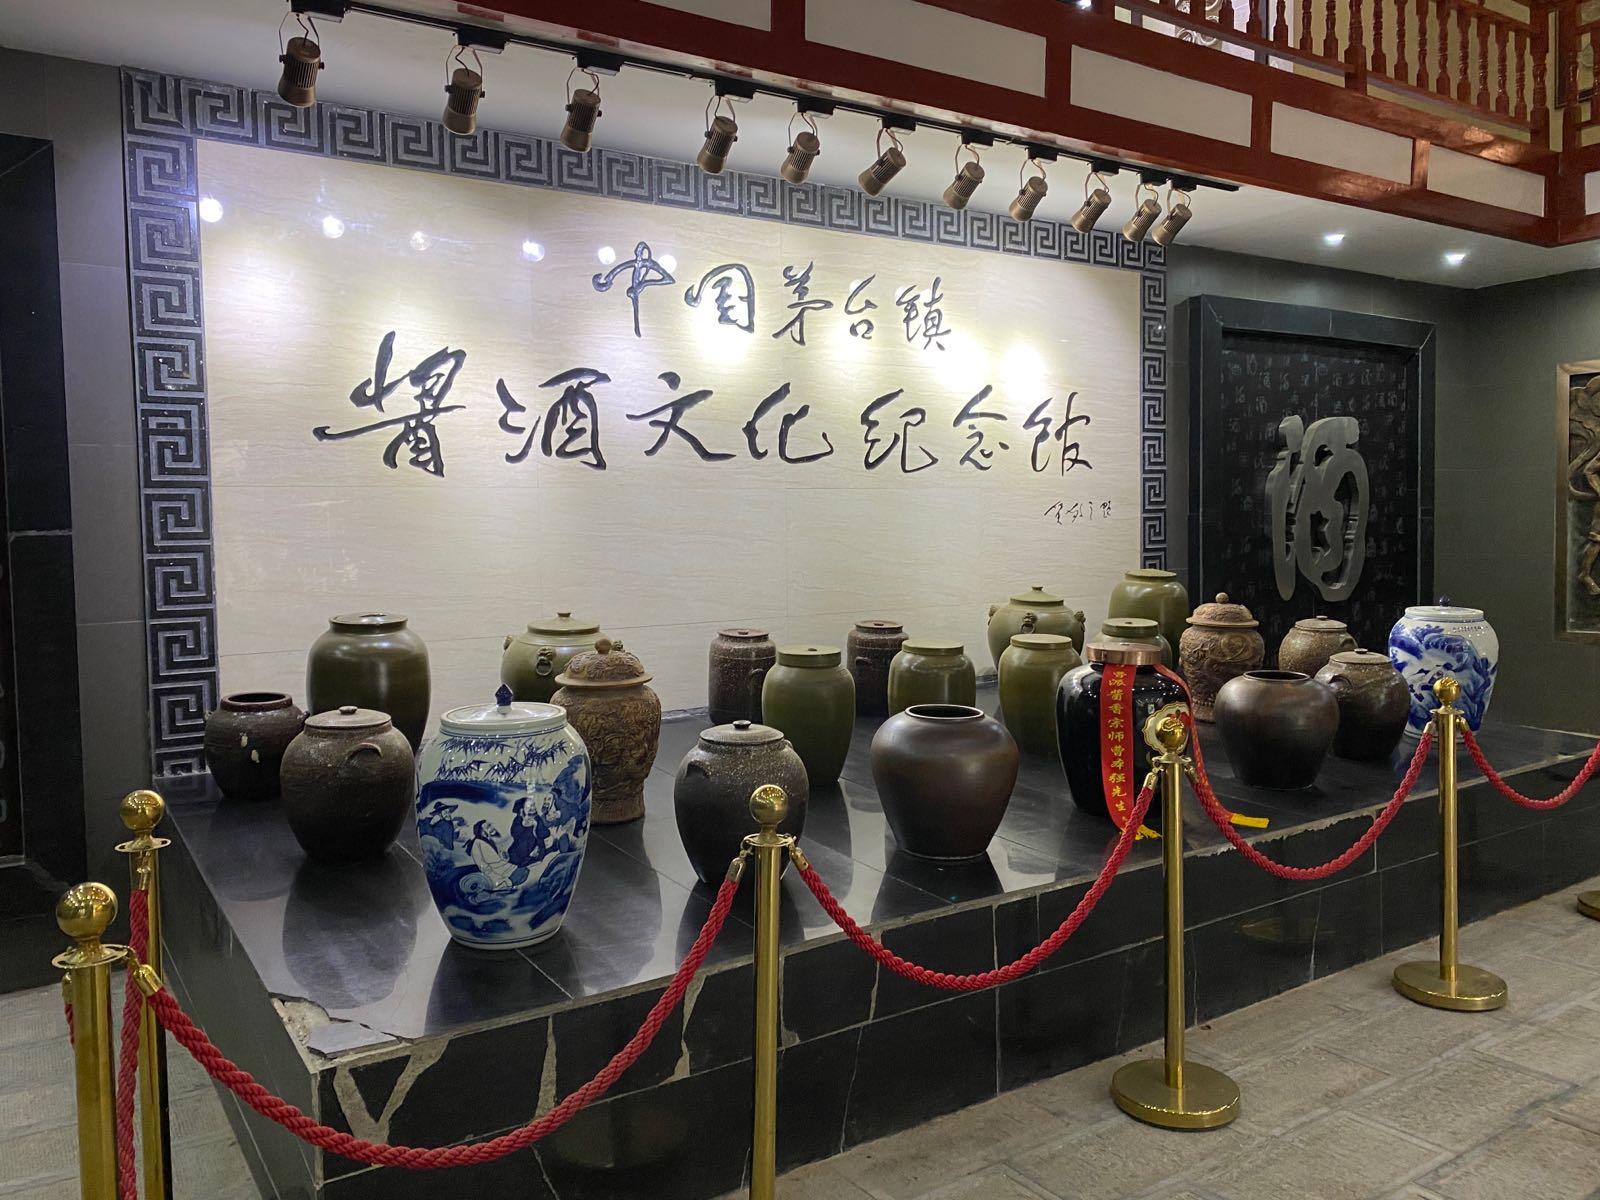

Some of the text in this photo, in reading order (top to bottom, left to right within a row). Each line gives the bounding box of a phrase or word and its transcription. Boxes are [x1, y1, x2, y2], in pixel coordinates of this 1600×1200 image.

[593, 241, 952, 351] 中国茅台镇
